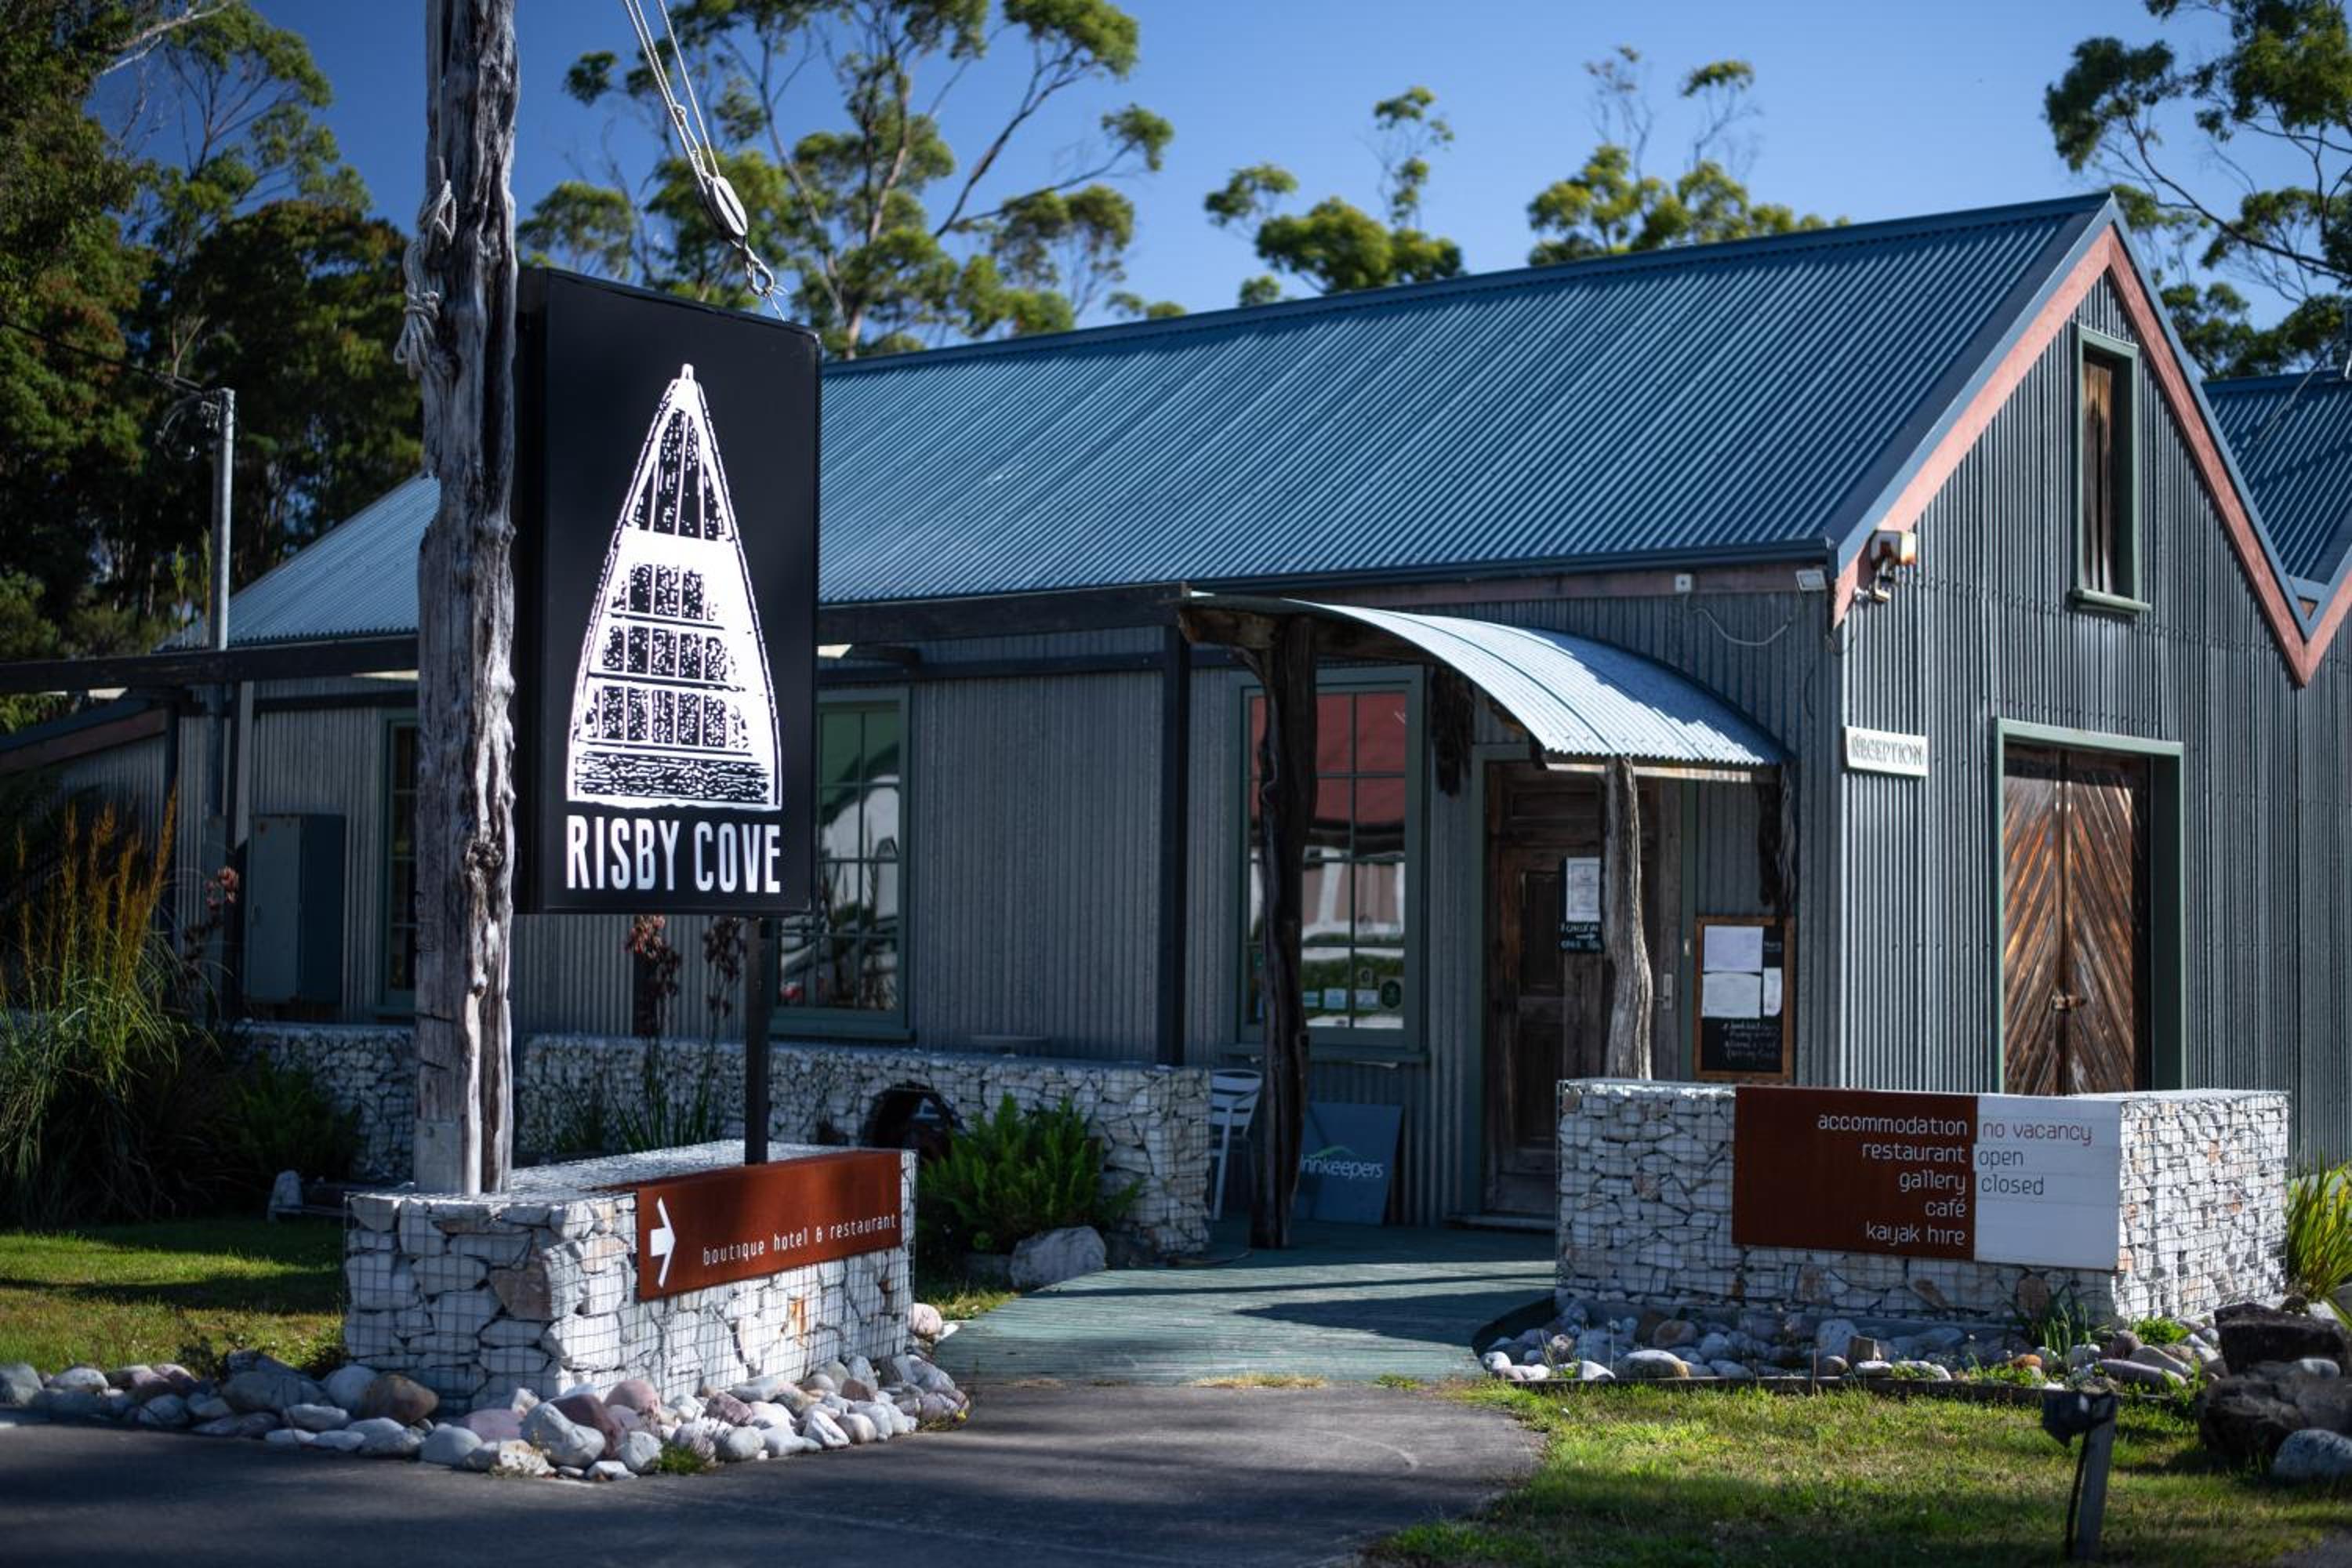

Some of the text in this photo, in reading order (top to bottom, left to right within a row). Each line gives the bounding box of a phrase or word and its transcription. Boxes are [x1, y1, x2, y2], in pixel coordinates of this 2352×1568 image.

[1851, 734, 1925, 766] RECEPTION
[566, 815, 781, 893] RISBY COVE
[1817, 1113, 2092, 1146] accommodation no vacancy
[1862, 1142, 2024, 1167] restaurant open
[1900, 1171, 2045, 1196] gallery closed
[1925, 1197, 1966, 1218] café
[702, 1214, 897, 1267] boutique hotel & restaurant
[1866, 1221, 1965, 1246] kayak hire
